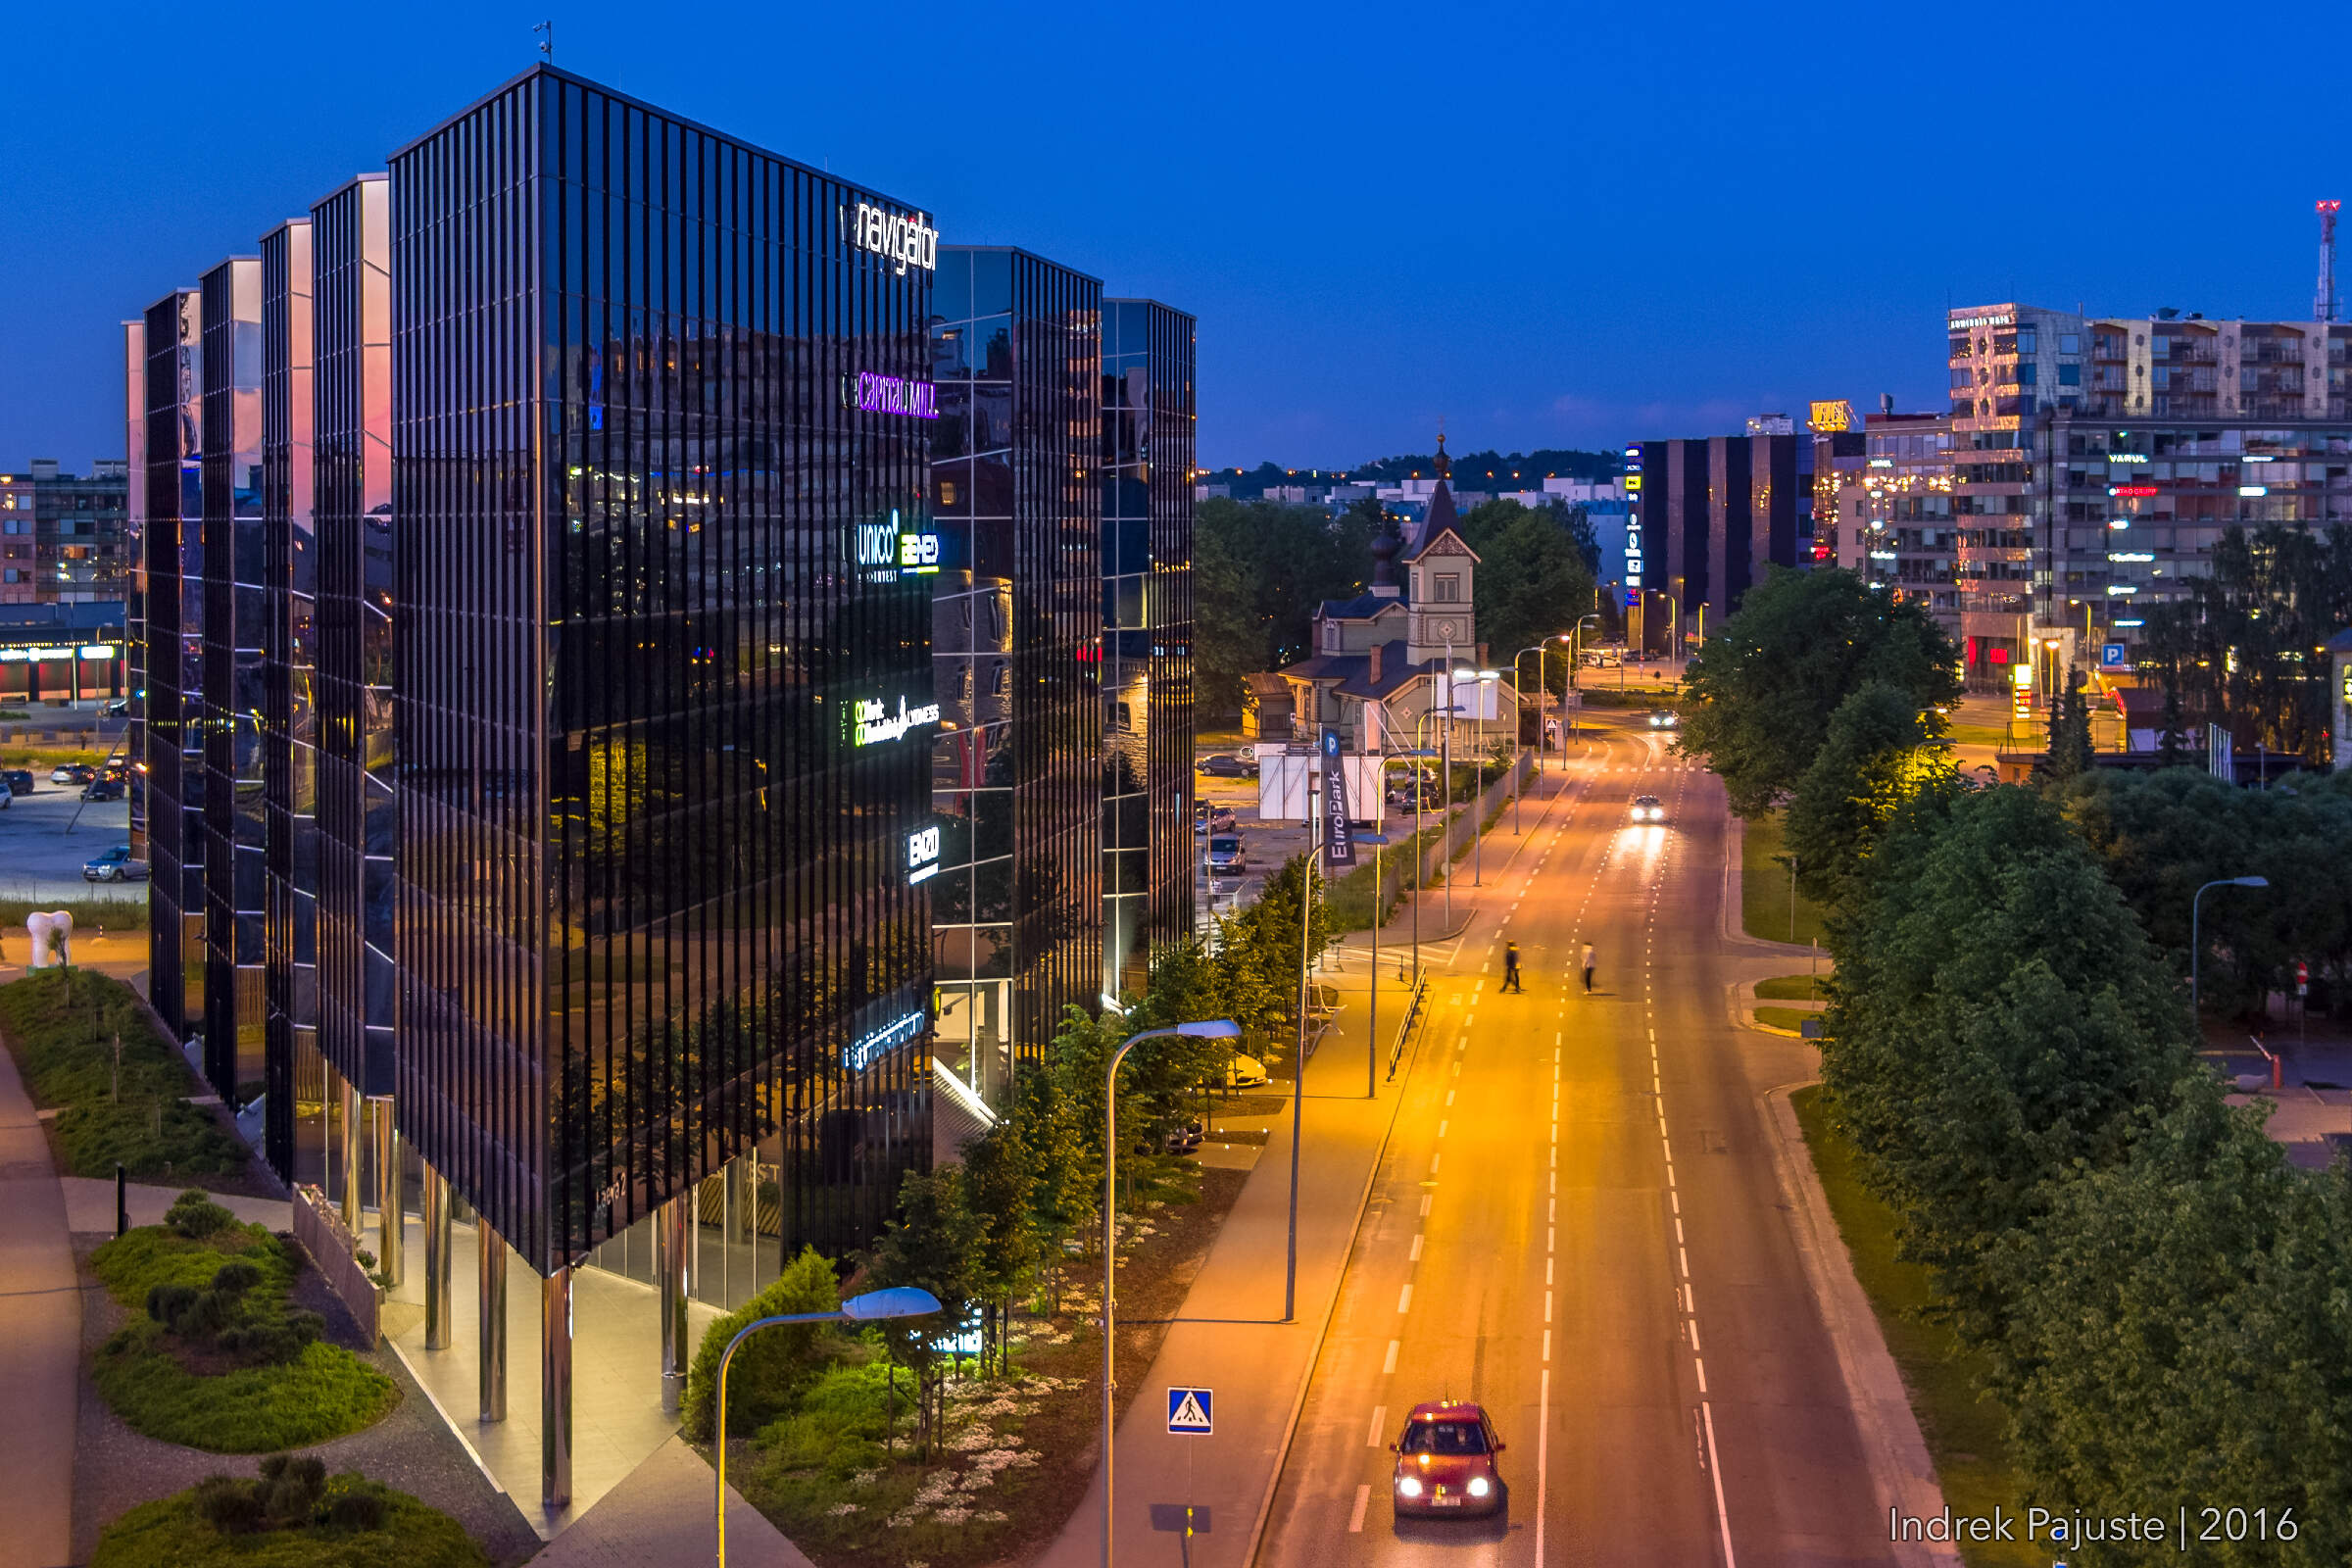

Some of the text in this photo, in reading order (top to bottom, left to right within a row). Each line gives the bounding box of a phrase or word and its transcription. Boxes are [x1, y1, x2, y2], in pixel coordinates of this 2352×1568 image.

[857, 202, 939, 276] navigator
[2107, 648, 2119, 662] P
[620, 1171, 627, 1197] 2
